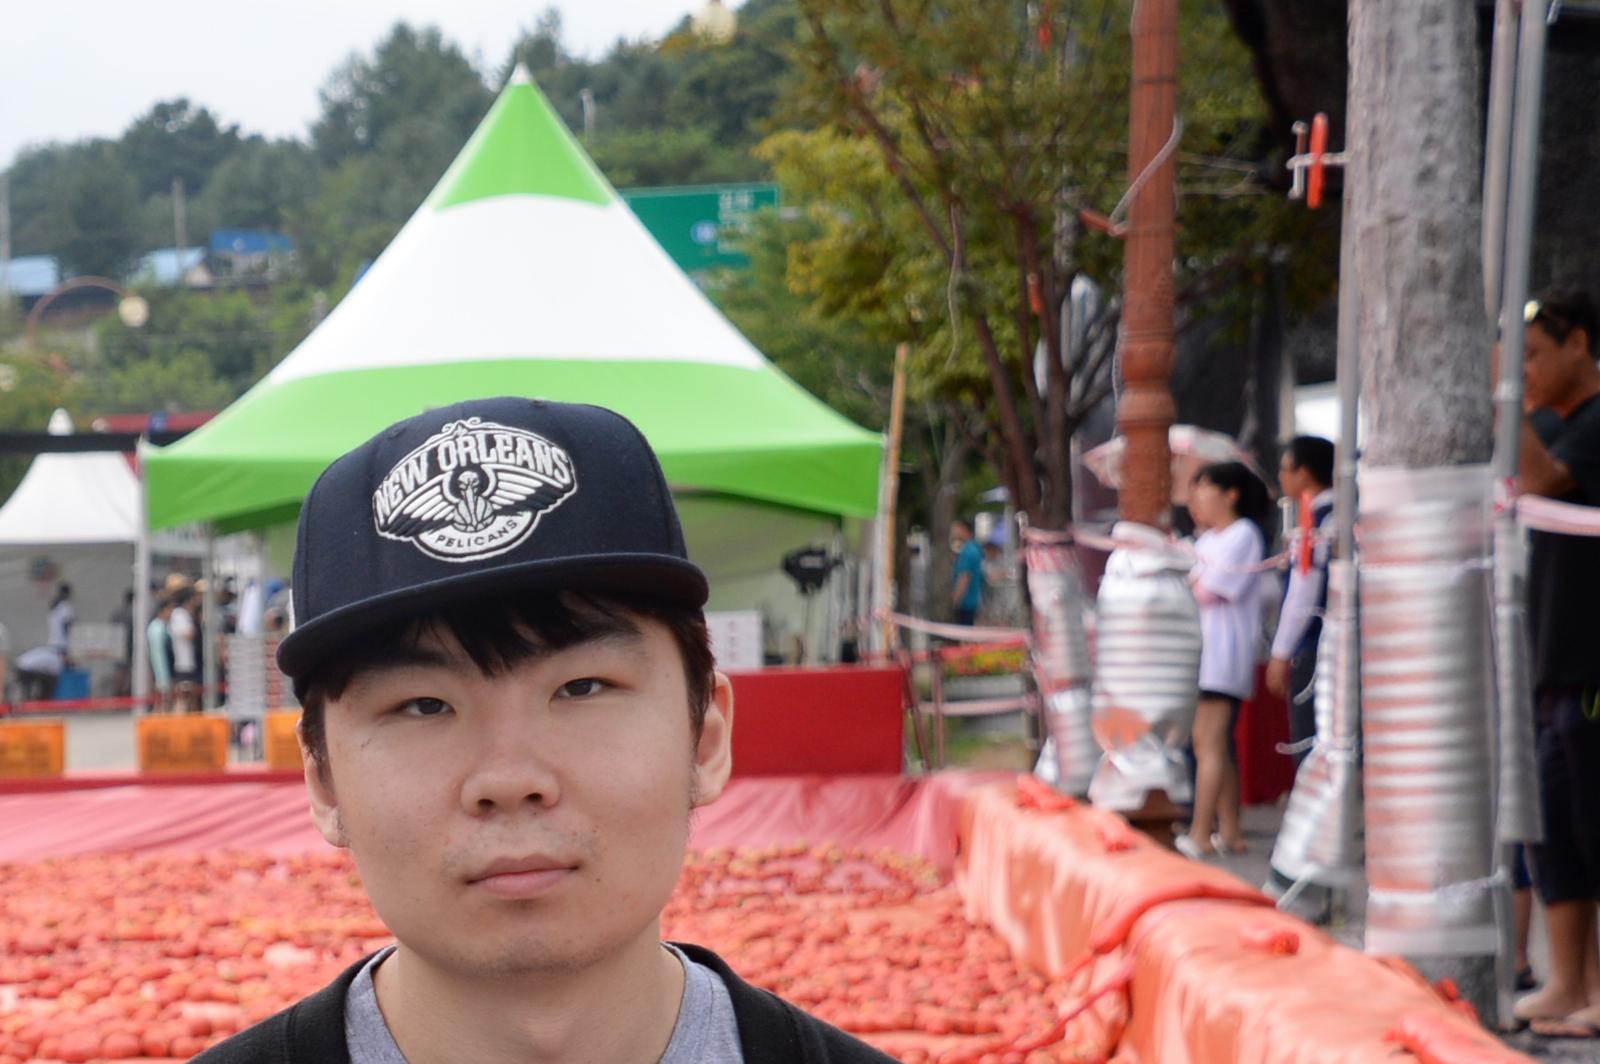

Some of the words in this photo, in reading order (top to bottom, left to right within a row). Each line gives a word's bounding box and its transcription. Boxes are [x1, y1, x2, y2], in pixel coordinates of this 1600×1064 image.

[374, 449, 430, 527] NEW
[436, 432, 572, 486] ORLEANS
[435, 519, 519, 549] PELICANS
